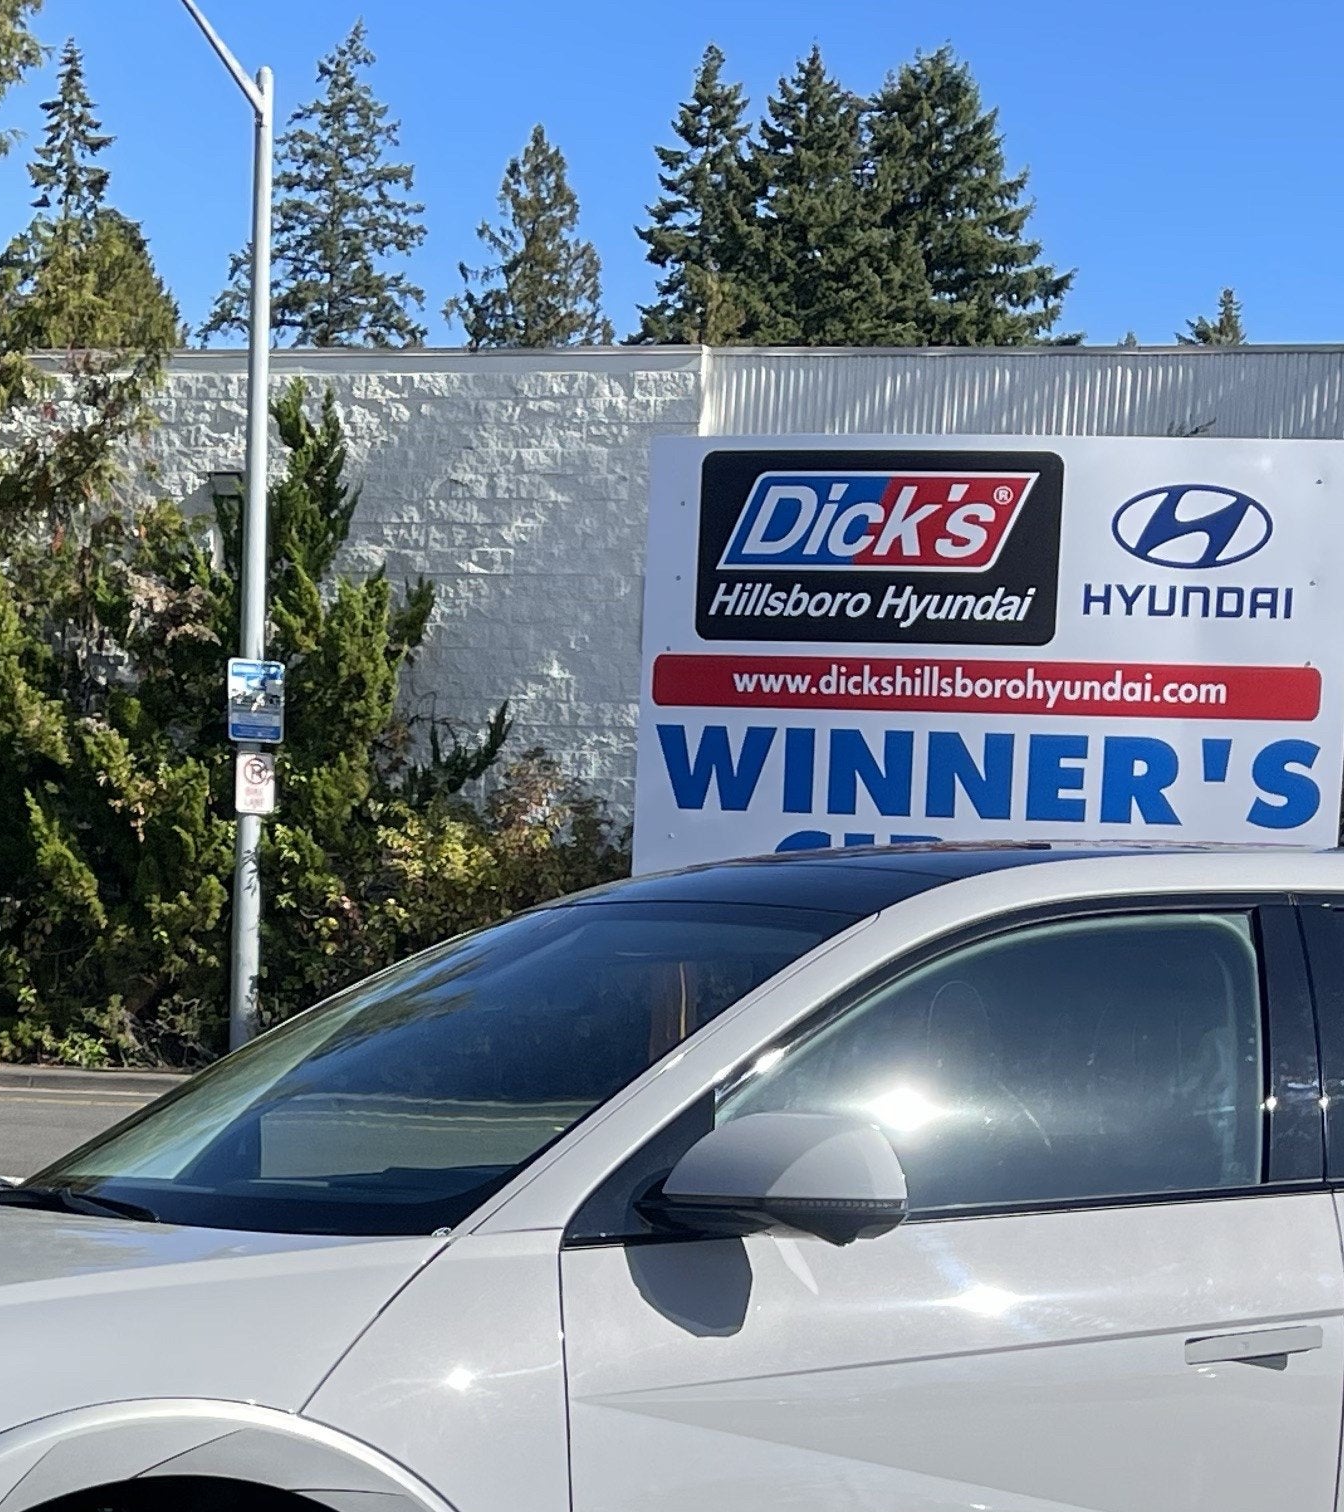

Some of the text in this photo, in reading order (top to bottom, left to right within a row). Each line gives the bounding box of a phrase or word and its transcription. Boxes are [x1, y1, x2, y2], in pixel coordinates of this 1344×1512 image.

[708, 582, 1036, 628] Hillsboro Hyundai
[1082, 583, 1294, 619] HYUNDAI
[732, 664, 1228, 708] www.dickshillsborohyundai.com
[655, 723, 1322, 830] WINNER'S
